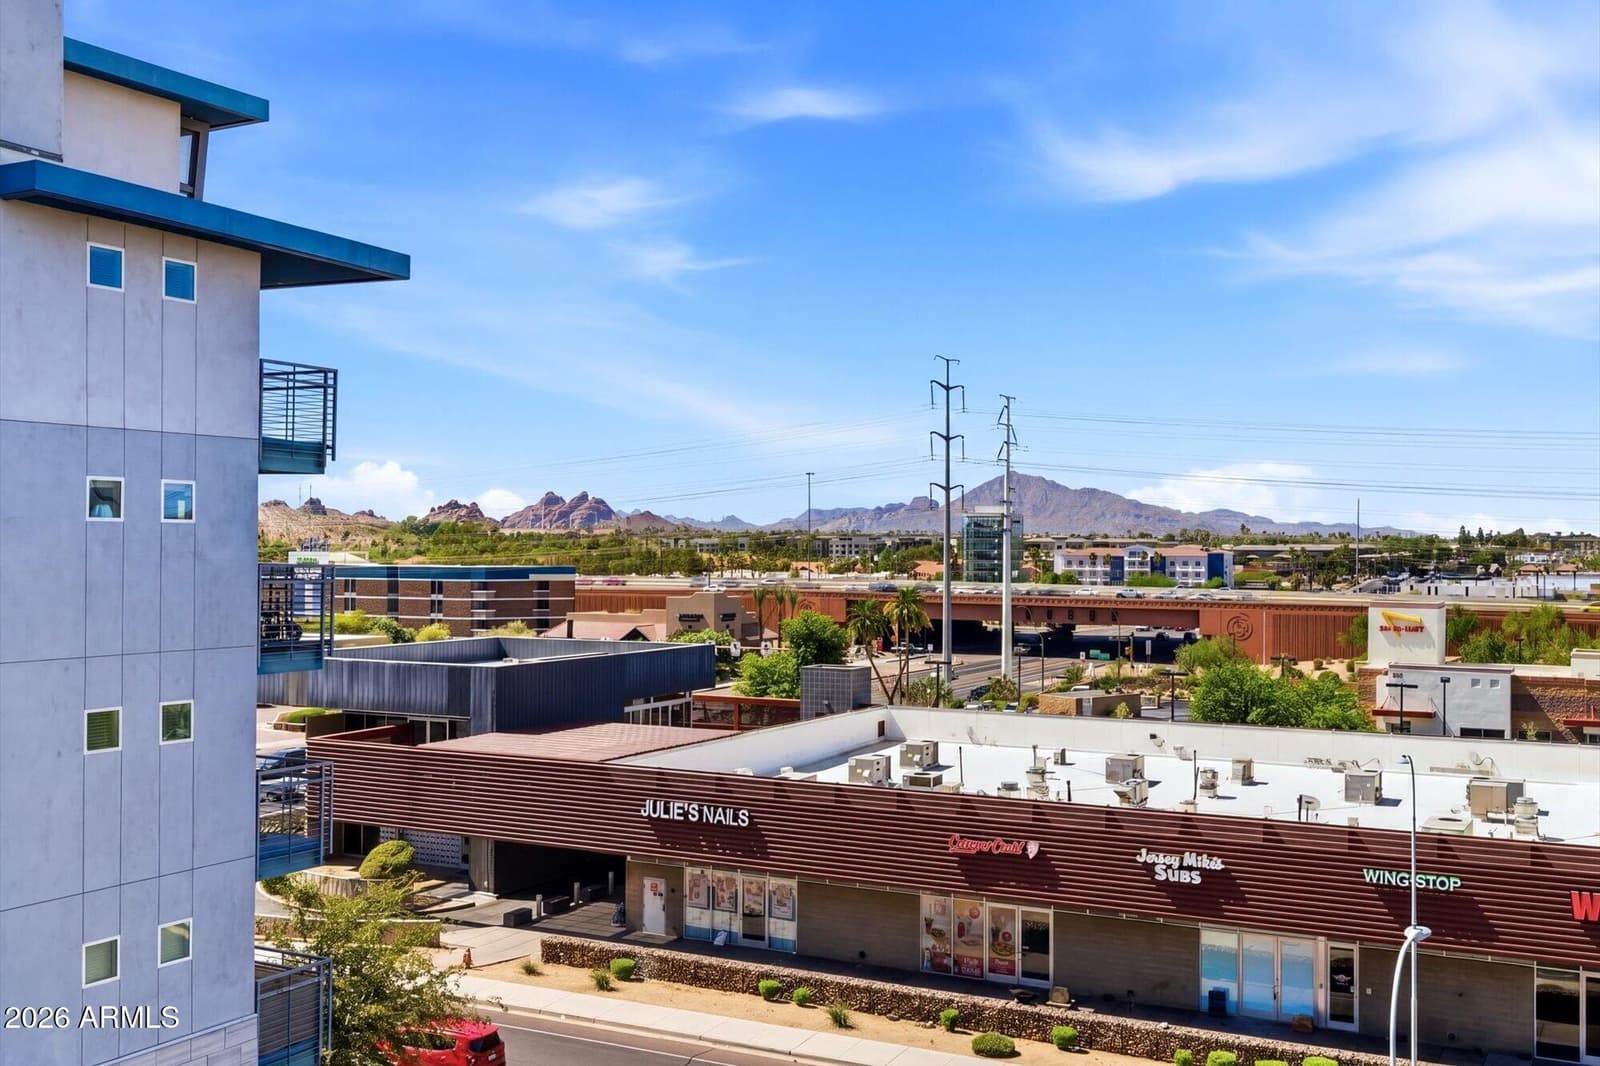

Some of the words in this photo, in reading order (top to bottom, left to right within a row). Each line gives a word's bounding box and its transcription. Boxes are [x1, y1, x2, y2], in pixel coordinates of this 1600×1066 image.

[641, 799, 699, 821] JULIE'S
[703, 805, 749, 826] NAILS
[1136, 848, 1180, 869] Jersey
